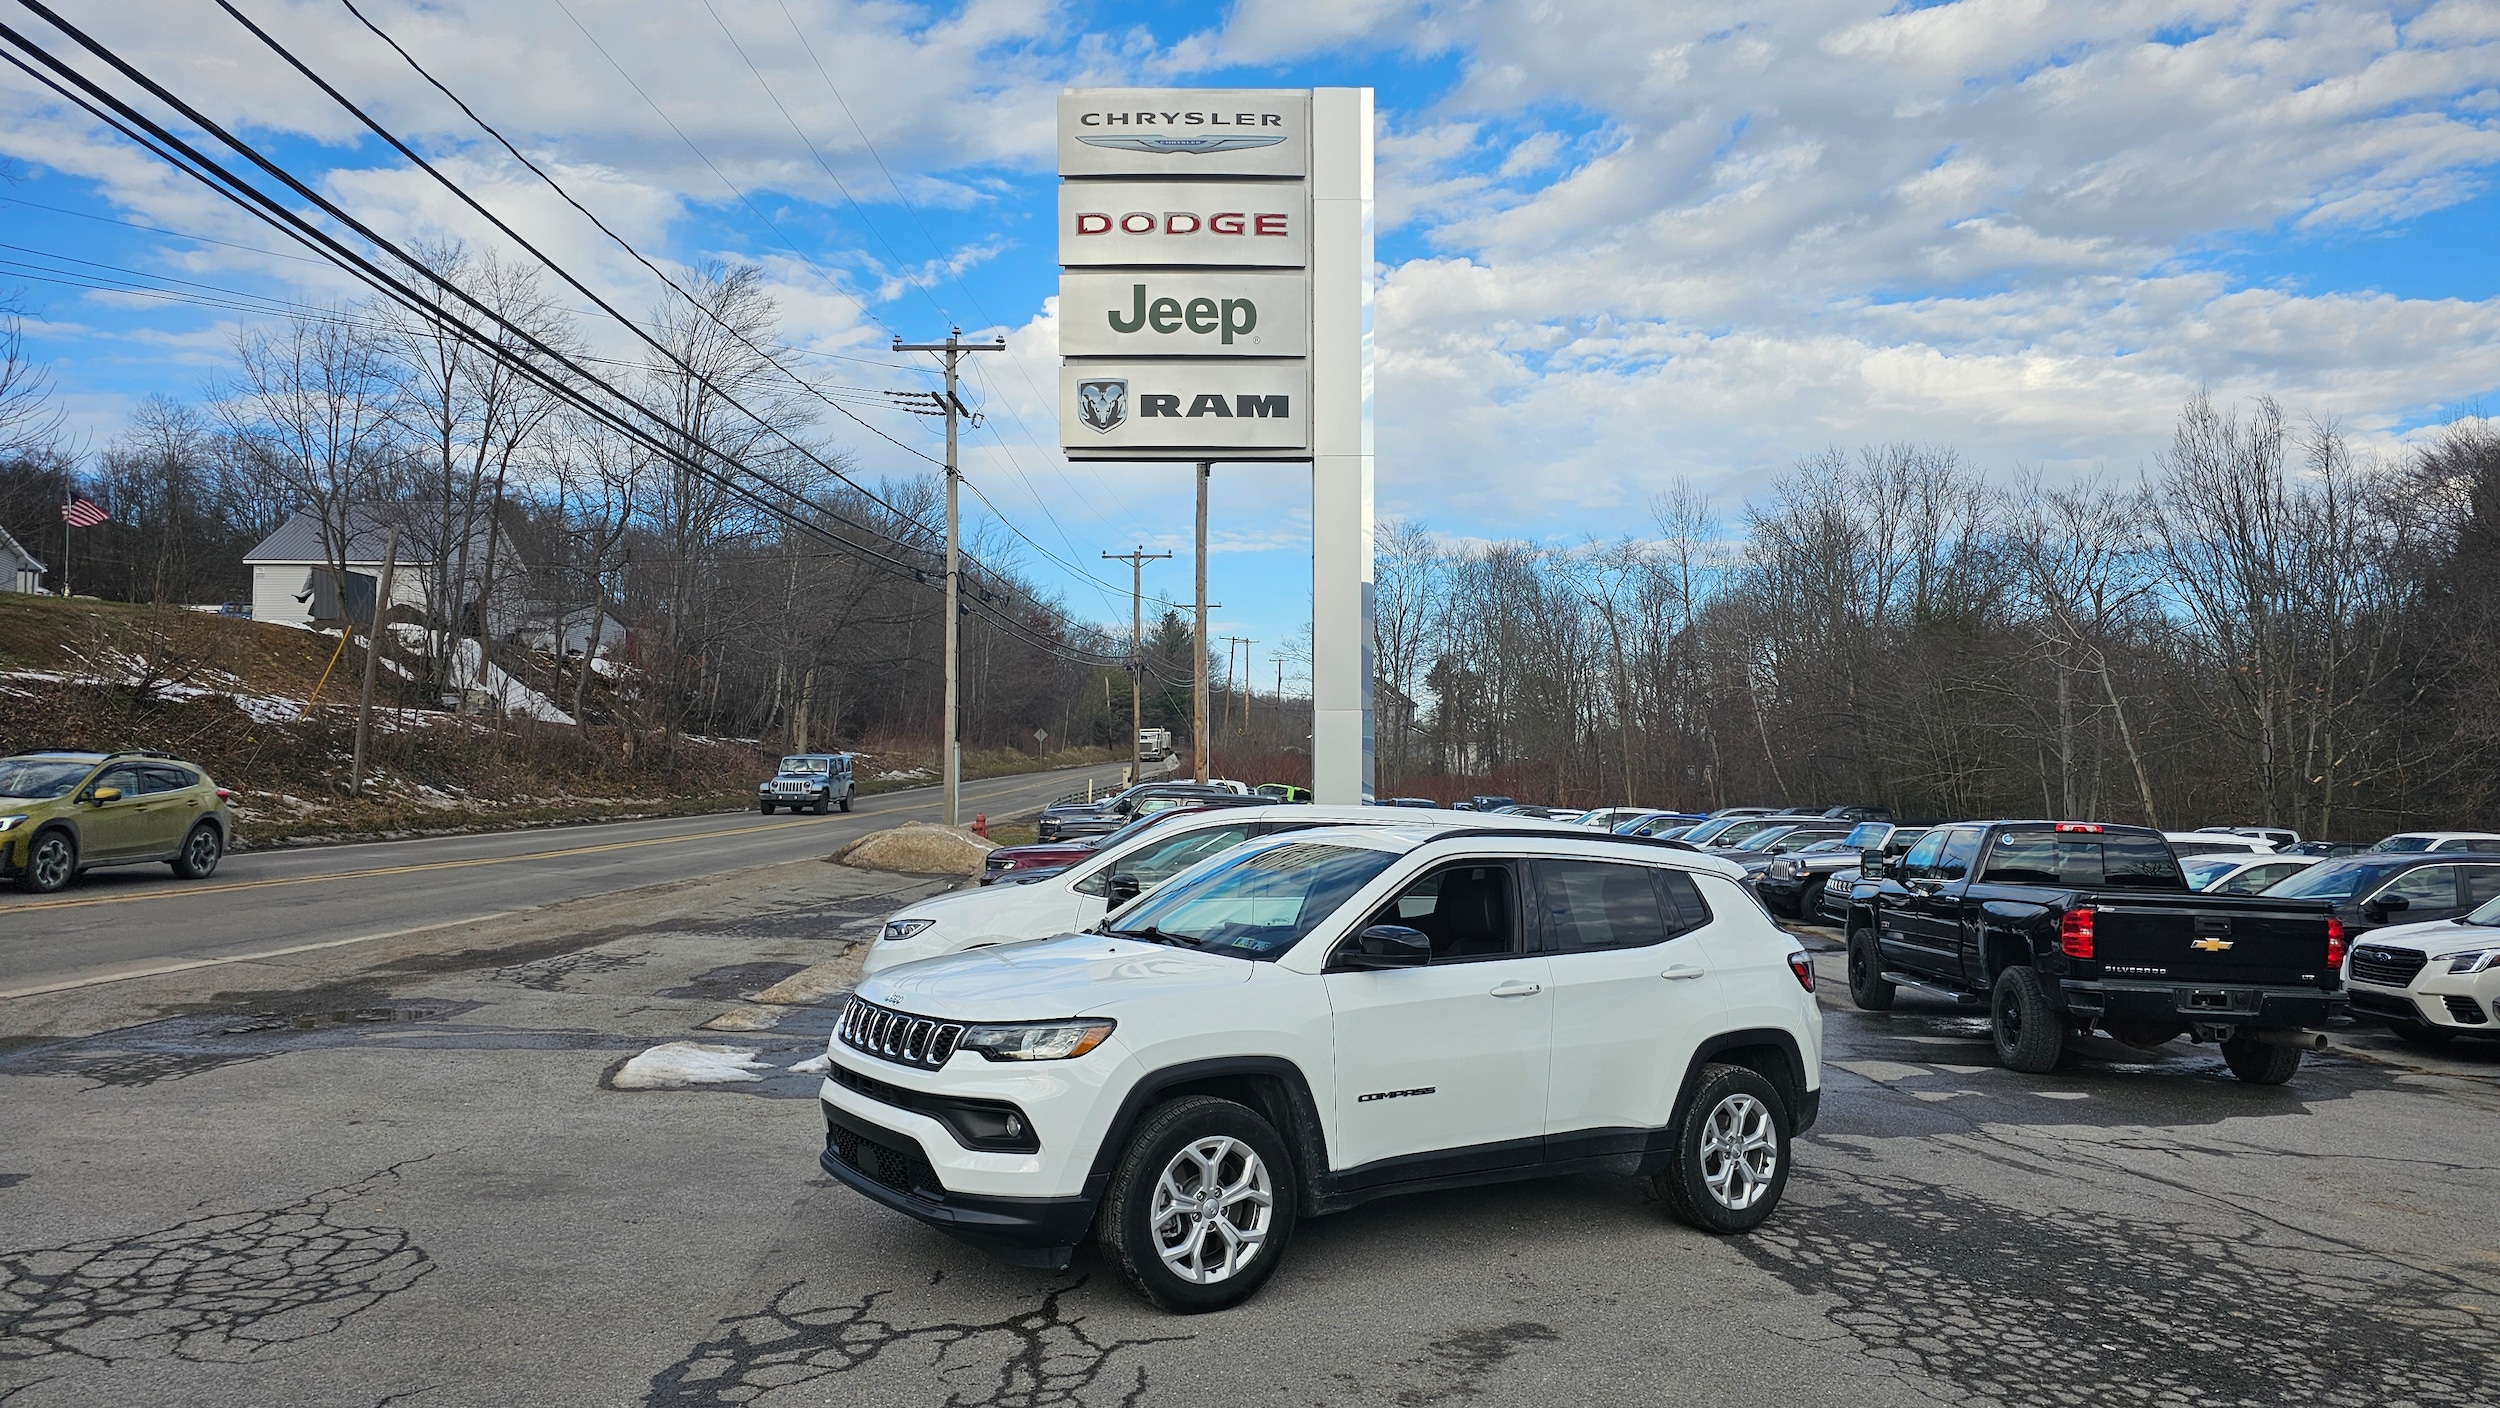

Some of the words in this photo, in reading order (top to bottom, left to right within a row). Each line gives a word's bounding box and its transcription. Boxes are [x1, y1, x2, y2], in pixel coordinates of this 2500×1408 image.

[1080, 112, 1282, 127] CHRYSLER
[1076, 212, 1289, 236] DODGE
[1108, 284, 1257, 345] Jeep
[1140, 394, 1289, 418] RAM
[2104, 965, 2167, 975] SILVERADO
[1358, 1086, 1436, 1102] COMPASS
